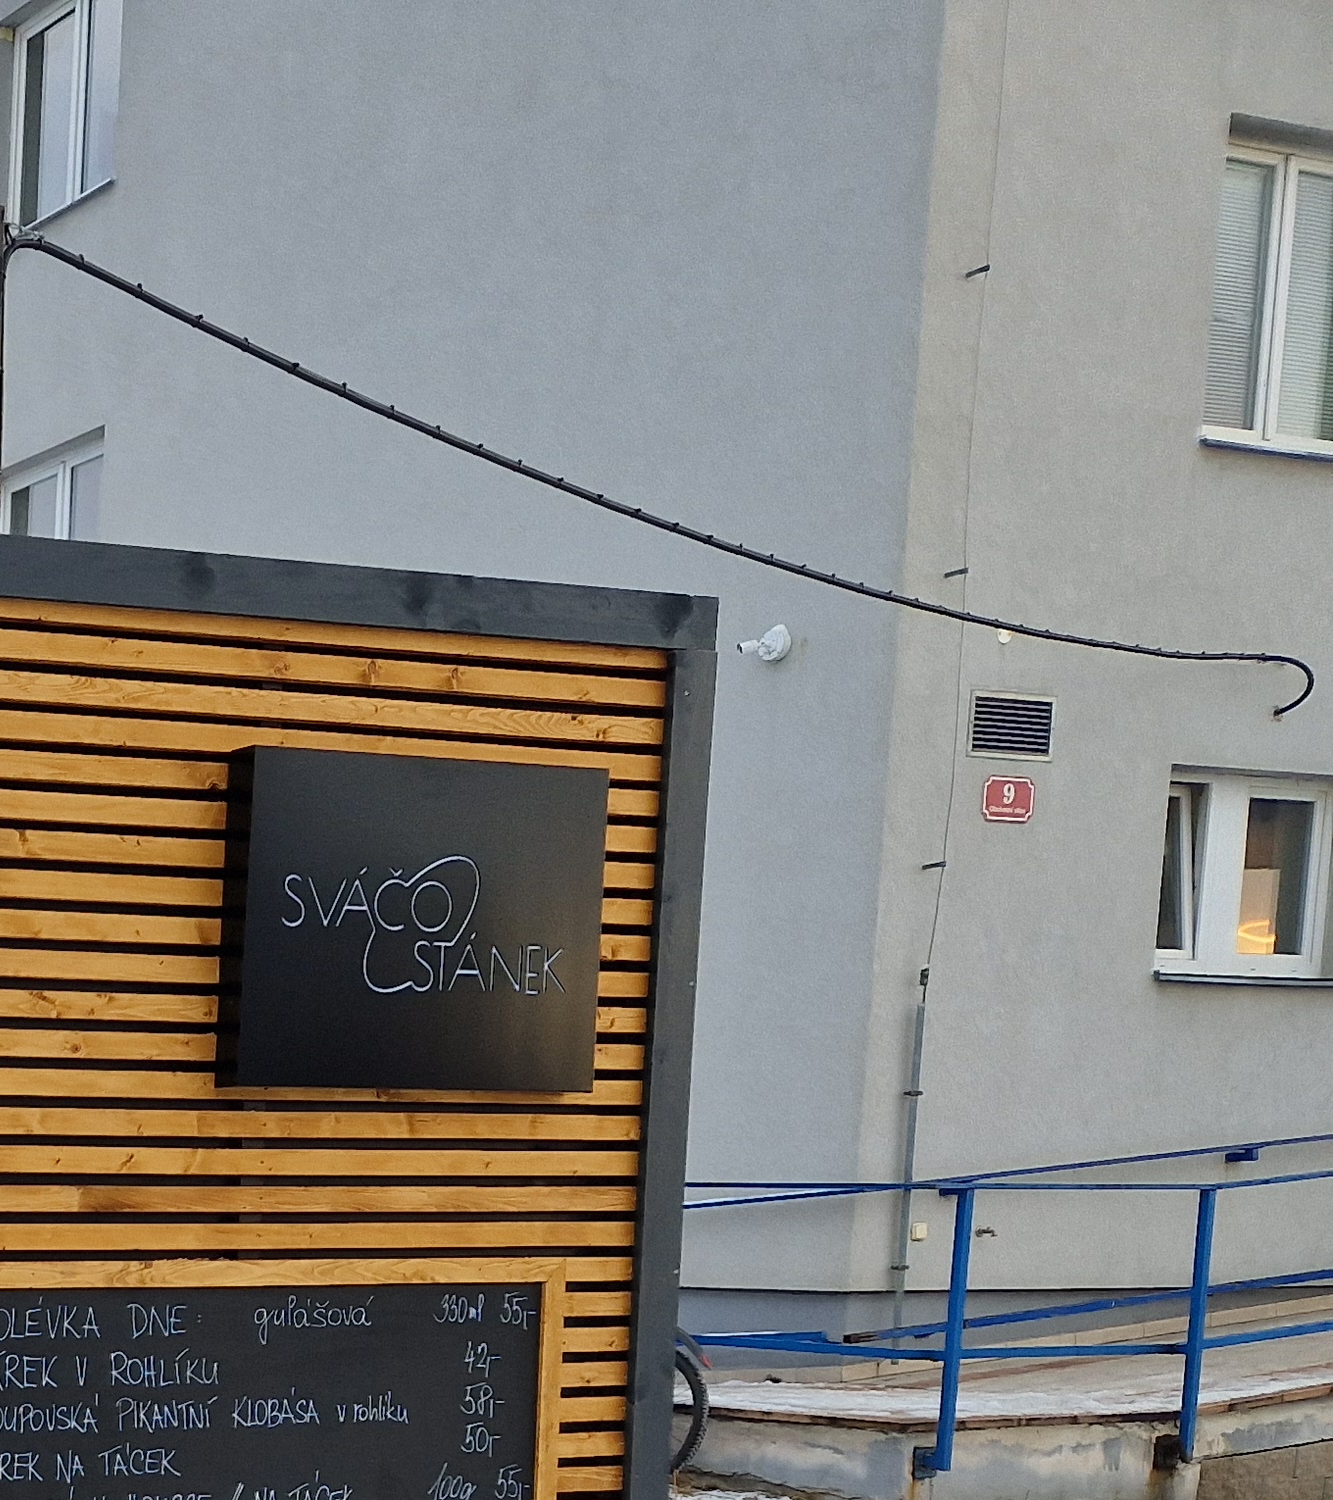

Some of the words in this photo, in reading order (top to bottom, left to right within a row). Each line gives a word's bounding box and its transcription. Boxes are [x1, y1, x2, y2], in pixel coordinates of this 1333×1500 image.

[1003, 783, 1014, 804] 9
[280, 866, 454, 932] SVÁČO
[413, 932, 566, 994] STÁNEK
[253, 1294, 375, 1345] gulášová
[499, 1292, 536, 1330] 55,-
[75, 1355, 87, 1387] V
[110, 1348, 220, 1388] ROHLÍKU
[463, 1341, 501, 1377] 42,-
[115, 1396, 218, 1434] PIKANTNÍ
[232, 1387, 321, 1429] KLOBÁSA
[336, 1403, 348, 1423] v
[353, 1391, 409, 1424] rohlíku
[460, 1382, 505, 1419] 58,-
[55, 1450, 85, 1484] NA
[461, 1421, 502, 1458] 50,-
